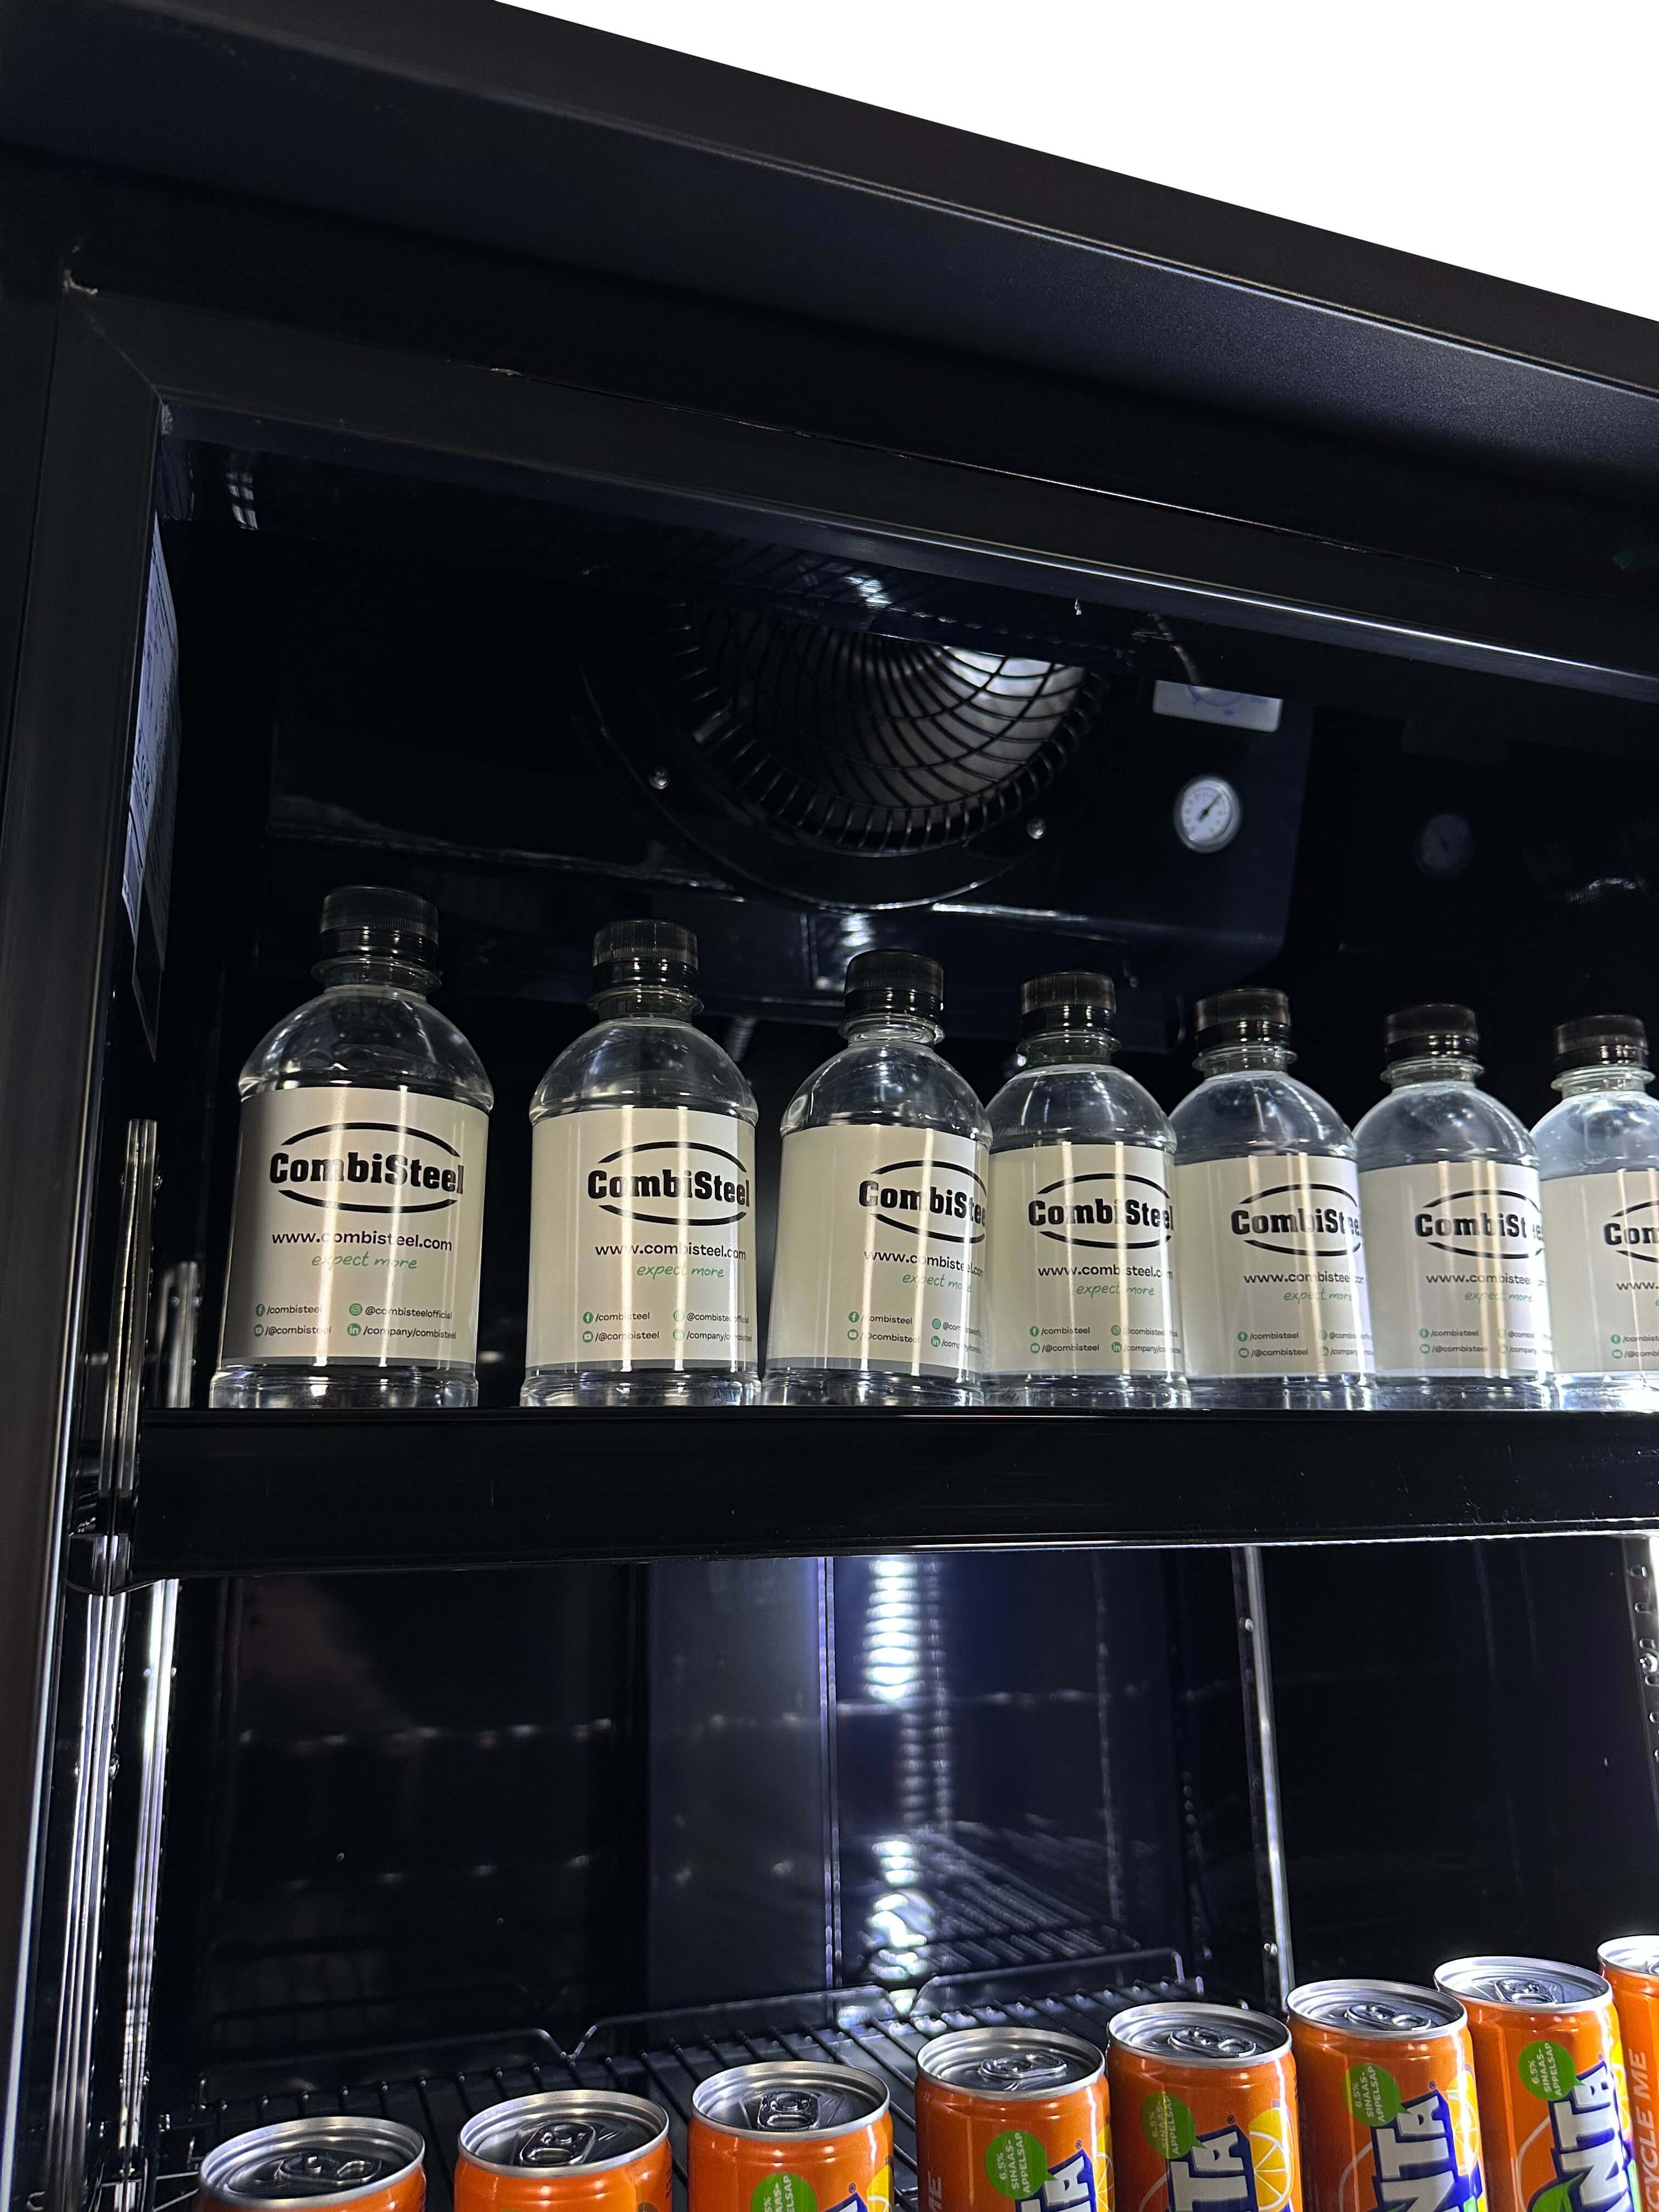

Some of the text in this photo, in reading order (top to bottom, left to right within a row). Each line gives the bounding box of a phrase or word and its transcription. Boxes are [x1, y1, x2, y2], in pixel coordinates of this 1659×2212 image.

[269, 1152, 464, 1194] CombiSteel
[588, 1169, 750, 1207] CombiSteel
[859, 1180, 986, 1227] CombiStee
[1028, 1198, 1174, 1231] CombiSteel
[272, 1231, 452, 1251] www.combisteel.com
[312, 1251, 417, 1269] expect more
[637, 1262, 724, 1280] expect more
[948, 1281, 973, 1293] moe
[1076, 1281, 1155, 1298] expect more
[365, 1306, 453, 1319] @combisteelofficial
[1041, 1326, 1090, 1335] /combisteel
[1250, 1331, 1299, 1341] /combisteel
[1042, 1344, 1099, 1353] /@combisteel
[1251, 1348, 1308, 1357] /@combisteel
[1528, 2059, 1539, 2084] 6.5%
[1537, 2049, 1551, 2094] SINAAS-
[1544, 2042, 1562, 2096] APPELSAP
[1628, 2048, 1651, 2100] ME
[1351, 2083, 1362, 2108] 6.5%
[1360, 2072, 1374, 2118] SINAAS-
[1368, 2065, 1385, 2123] APPELSAP
[1165, 2095, 1180, 2155] APPELSAP
[997, 2152, 1008, 2180] 6.5%
[1005, 2139, 1020, 2190] SINAAS-
[1015, 2132, 1031, 2193] APPELSAP
